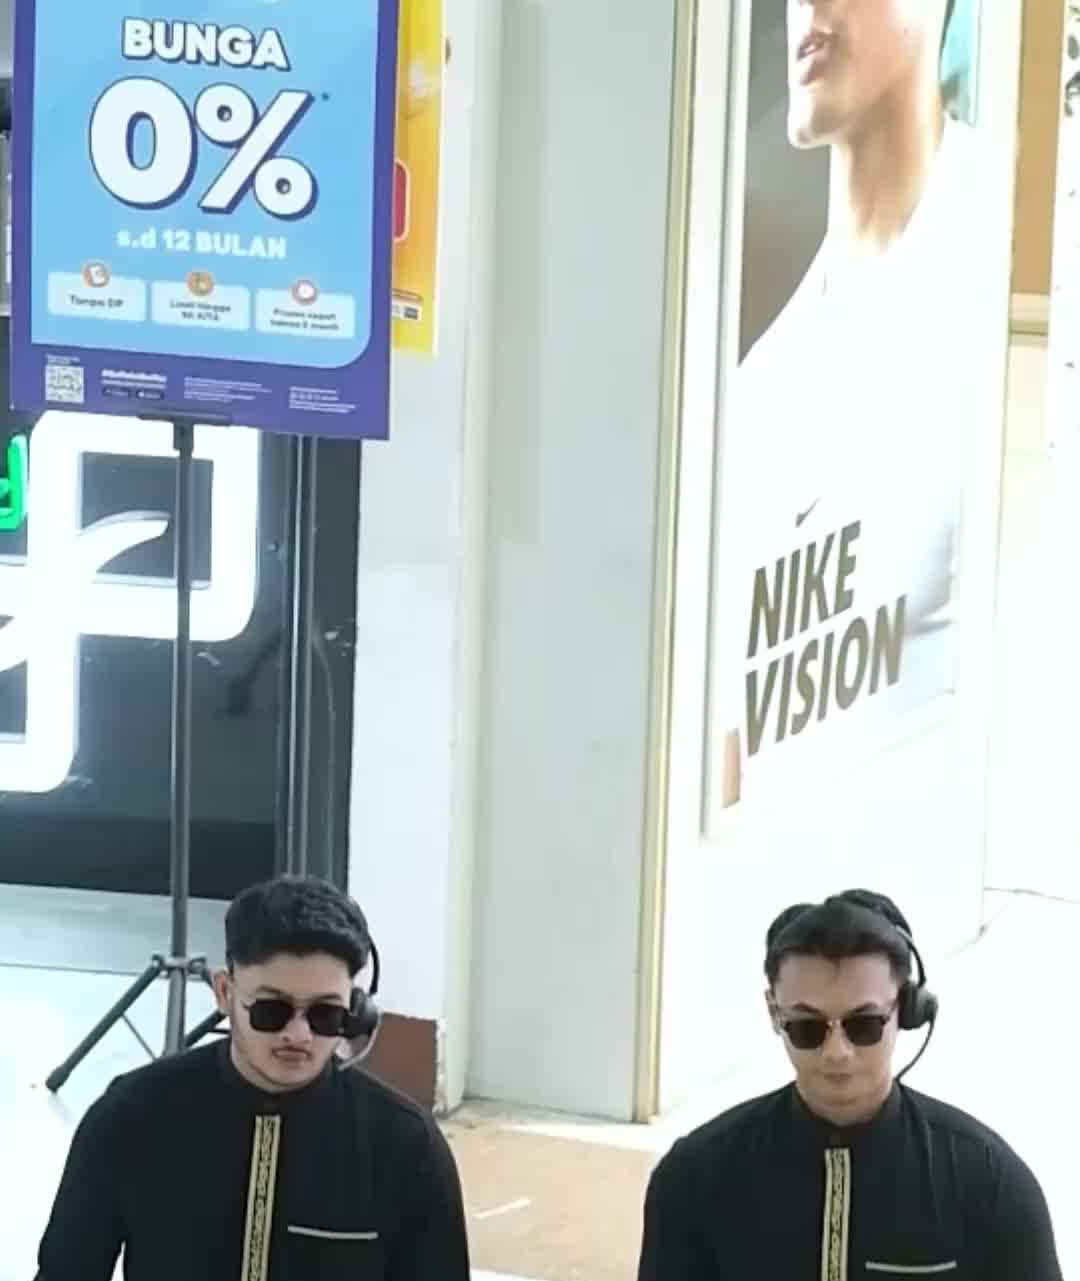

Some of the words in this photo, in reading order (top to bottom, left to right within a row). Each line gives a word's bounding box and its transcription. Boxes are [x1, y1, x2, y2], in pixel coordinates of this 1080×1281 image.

[122, 17, 291, 71] BUNGA
[117, 228, 157, 250] s.d
[162, 229, 191, 252] 12
[195, 230, 287, 260] BULAN
[746, 519, 861, 659] NIKE
[745, 593, 907, 758] VISION
